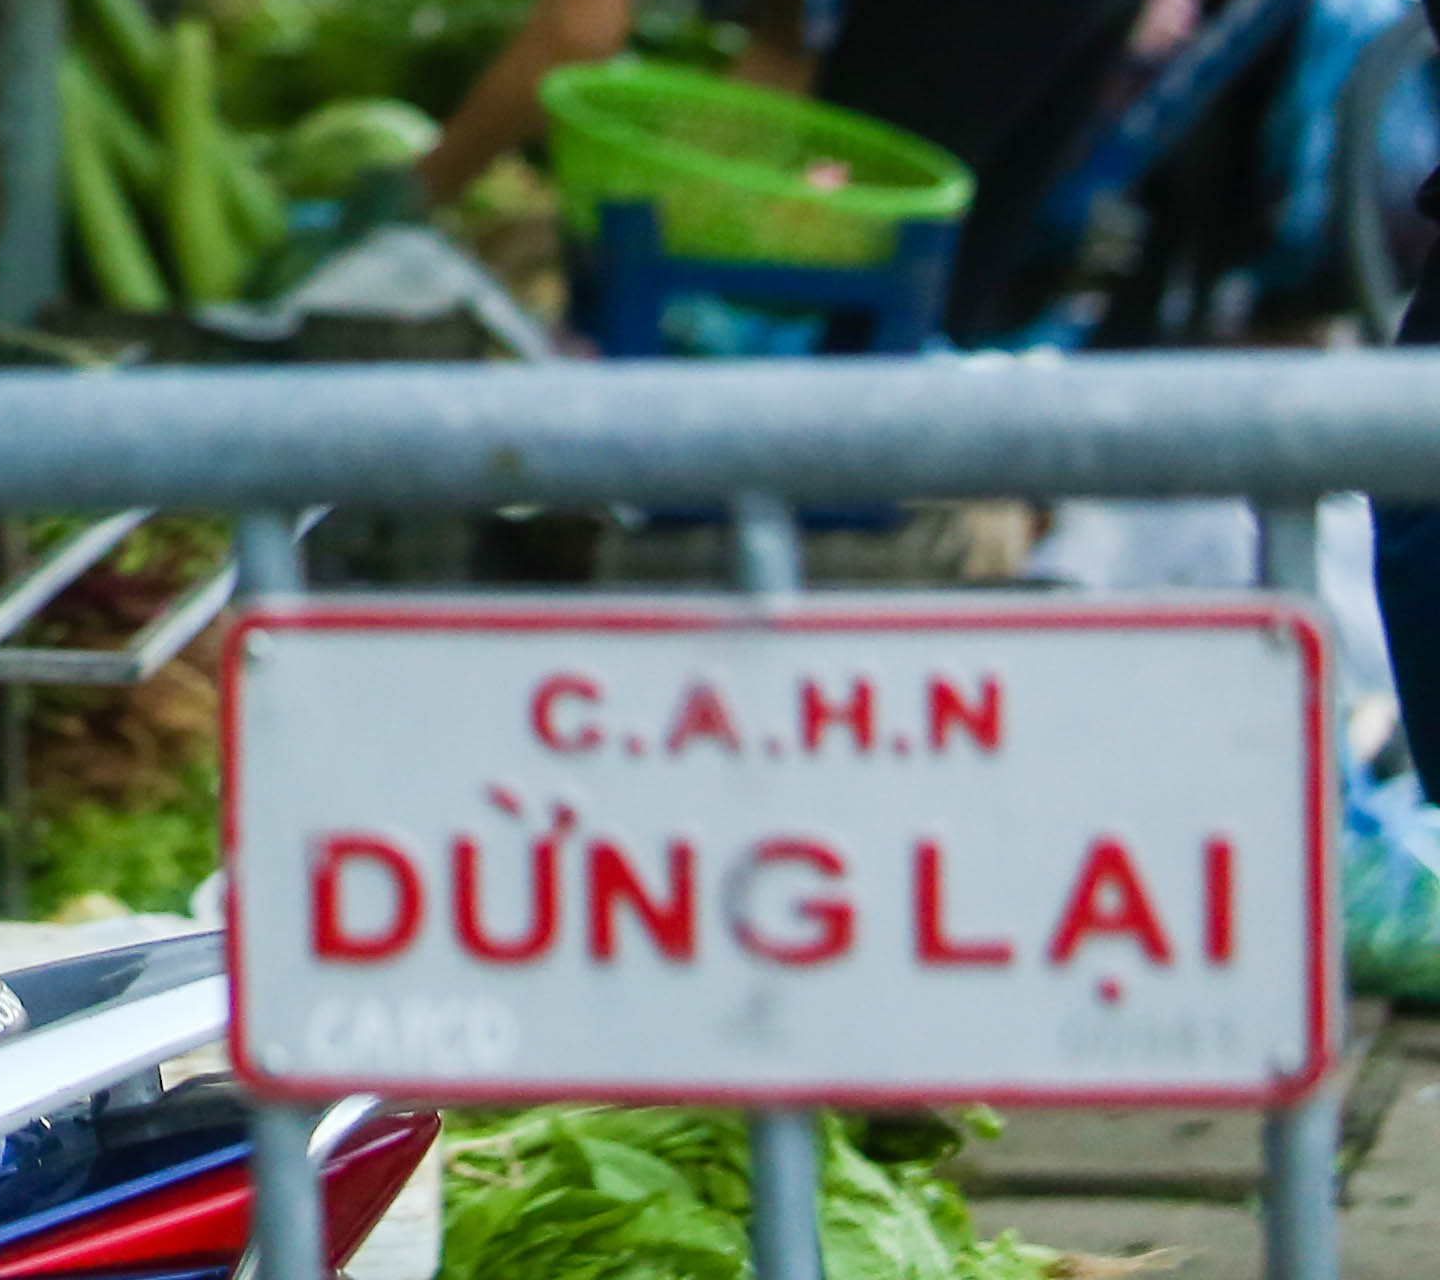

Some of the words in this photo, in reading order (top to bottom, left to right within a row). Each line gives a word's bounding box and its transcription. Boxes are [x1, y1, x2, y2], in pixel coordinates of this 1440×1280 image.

[529, 672, 1006, 754] C.A.H.N
[307, 785, 858, 967] DỪNG
[913, 835, 1235, 1005] LẠI
